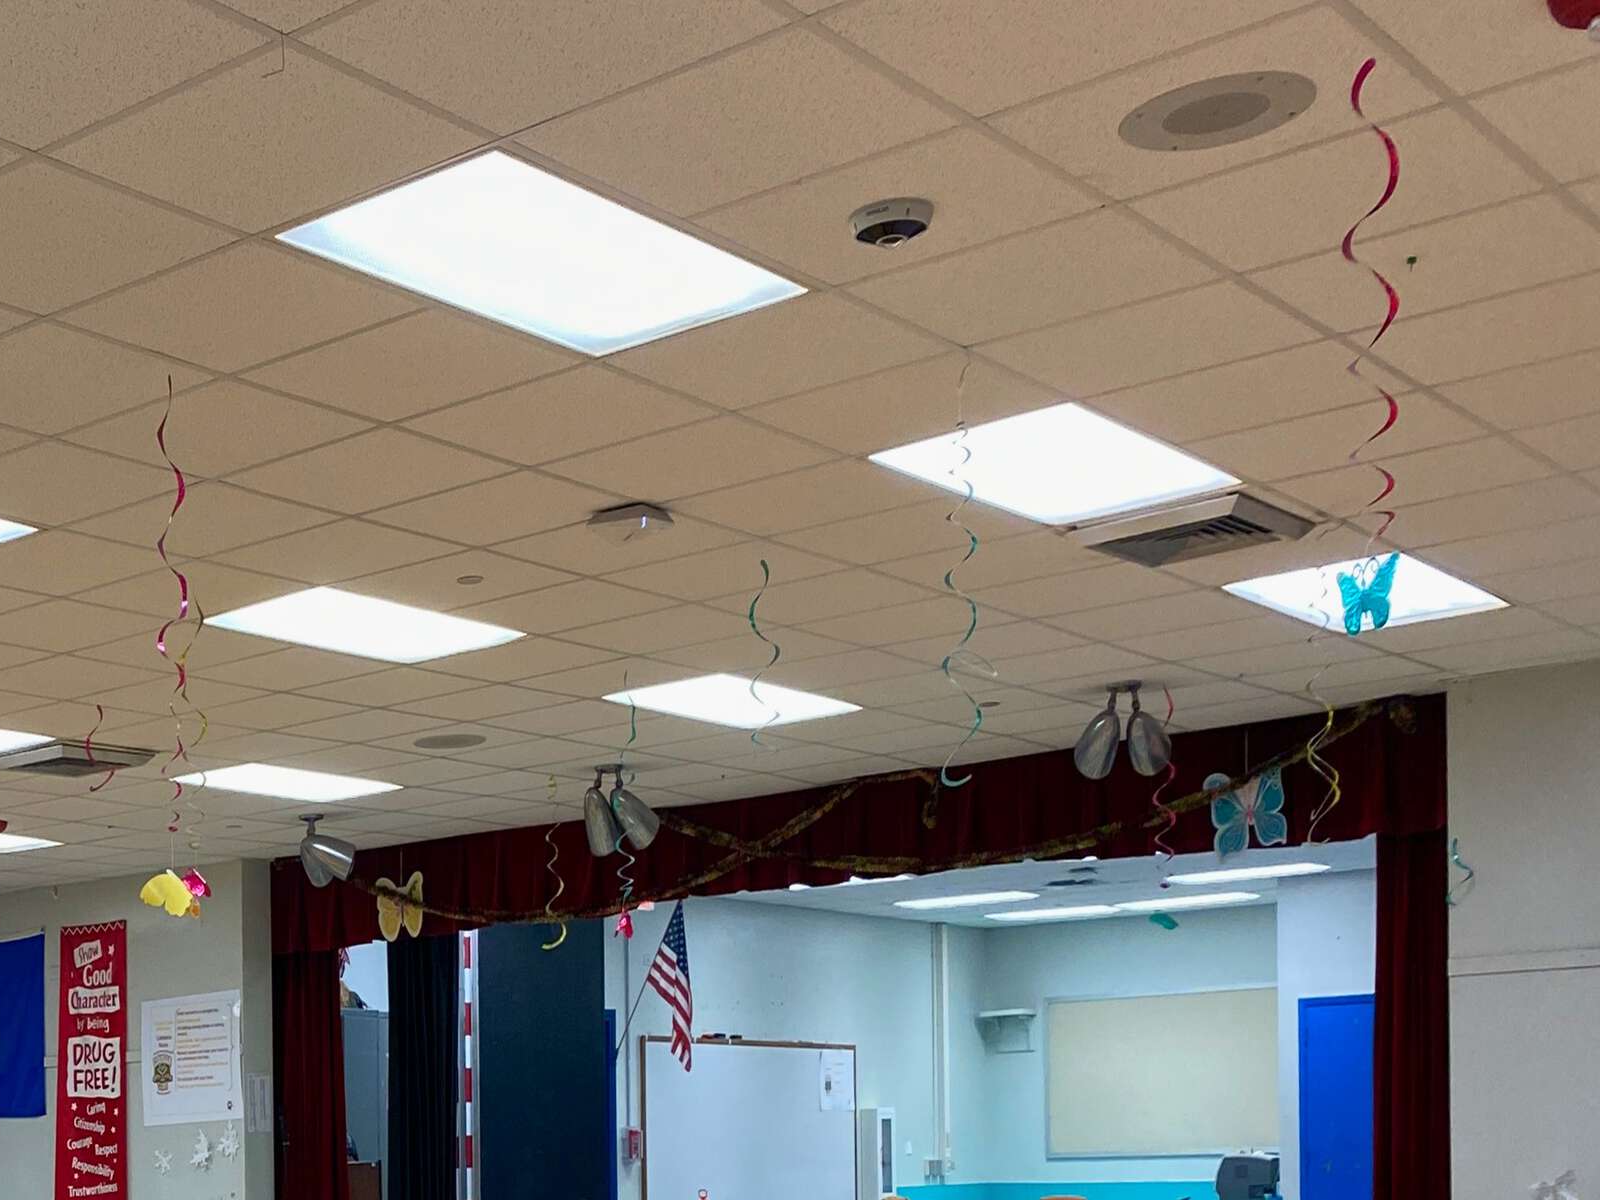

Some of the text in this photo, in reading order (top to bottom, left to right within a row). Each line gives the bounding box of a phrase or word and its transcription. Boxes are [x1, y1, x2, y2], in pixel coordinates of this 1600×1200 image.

[83, 962, 113, 986] Good
[71, 991, 117, 1010] Character
[77, 1017, 109, 1033] by being
[73, 1040, 116, 1065] DRUG
[73, 1067, 116, 1092] FREE!
[86, 1102, 106, 1115] Caring
[74, 1117, 105, 1135] Citizenship
[67, 1136, 93, 1150] Courage
[95, 1143, 118, 1157] Respect
[72, 1156, 114, 1180] Responsibility
[68, 1182, 118, 1197] Trustworthiness
